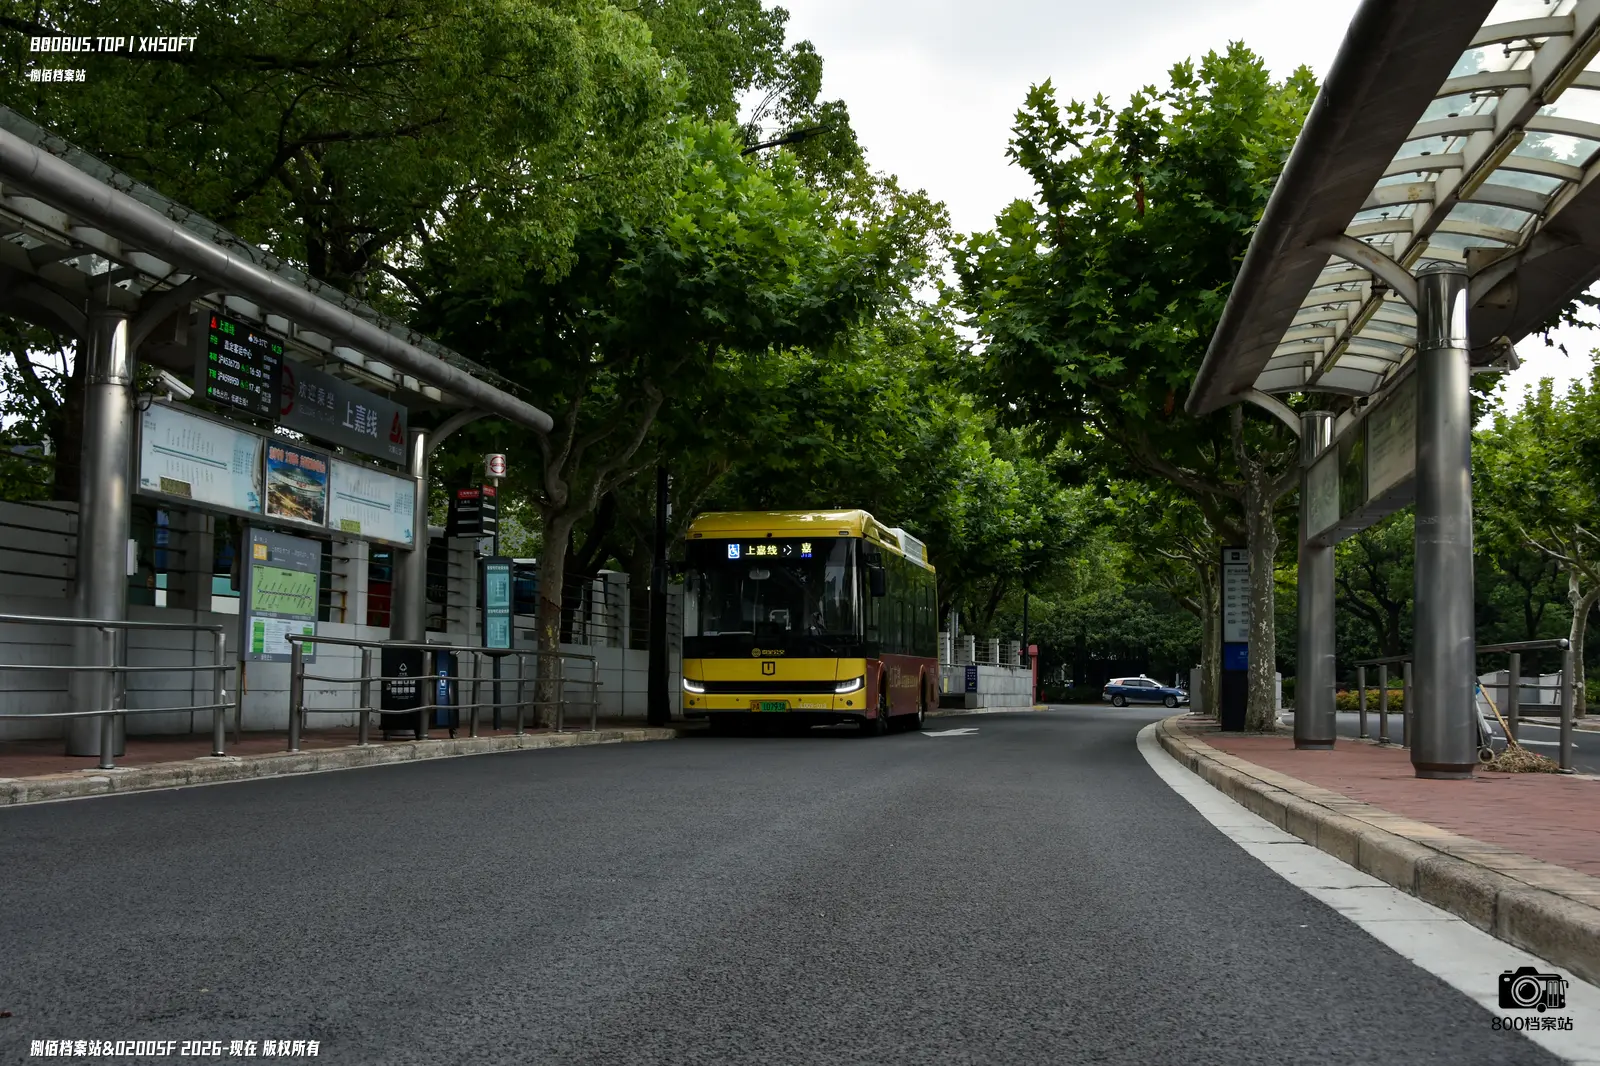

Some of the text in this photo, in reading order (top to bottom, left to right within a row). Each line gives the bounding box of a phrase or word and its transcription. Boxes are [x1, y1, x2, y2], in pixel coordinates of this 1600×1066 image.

[298, 381, 335, 410] 欢迎乘坐
[342, 400, 378, 439] 上嘉线
[745, 544, 778, 556] 上嘉线
